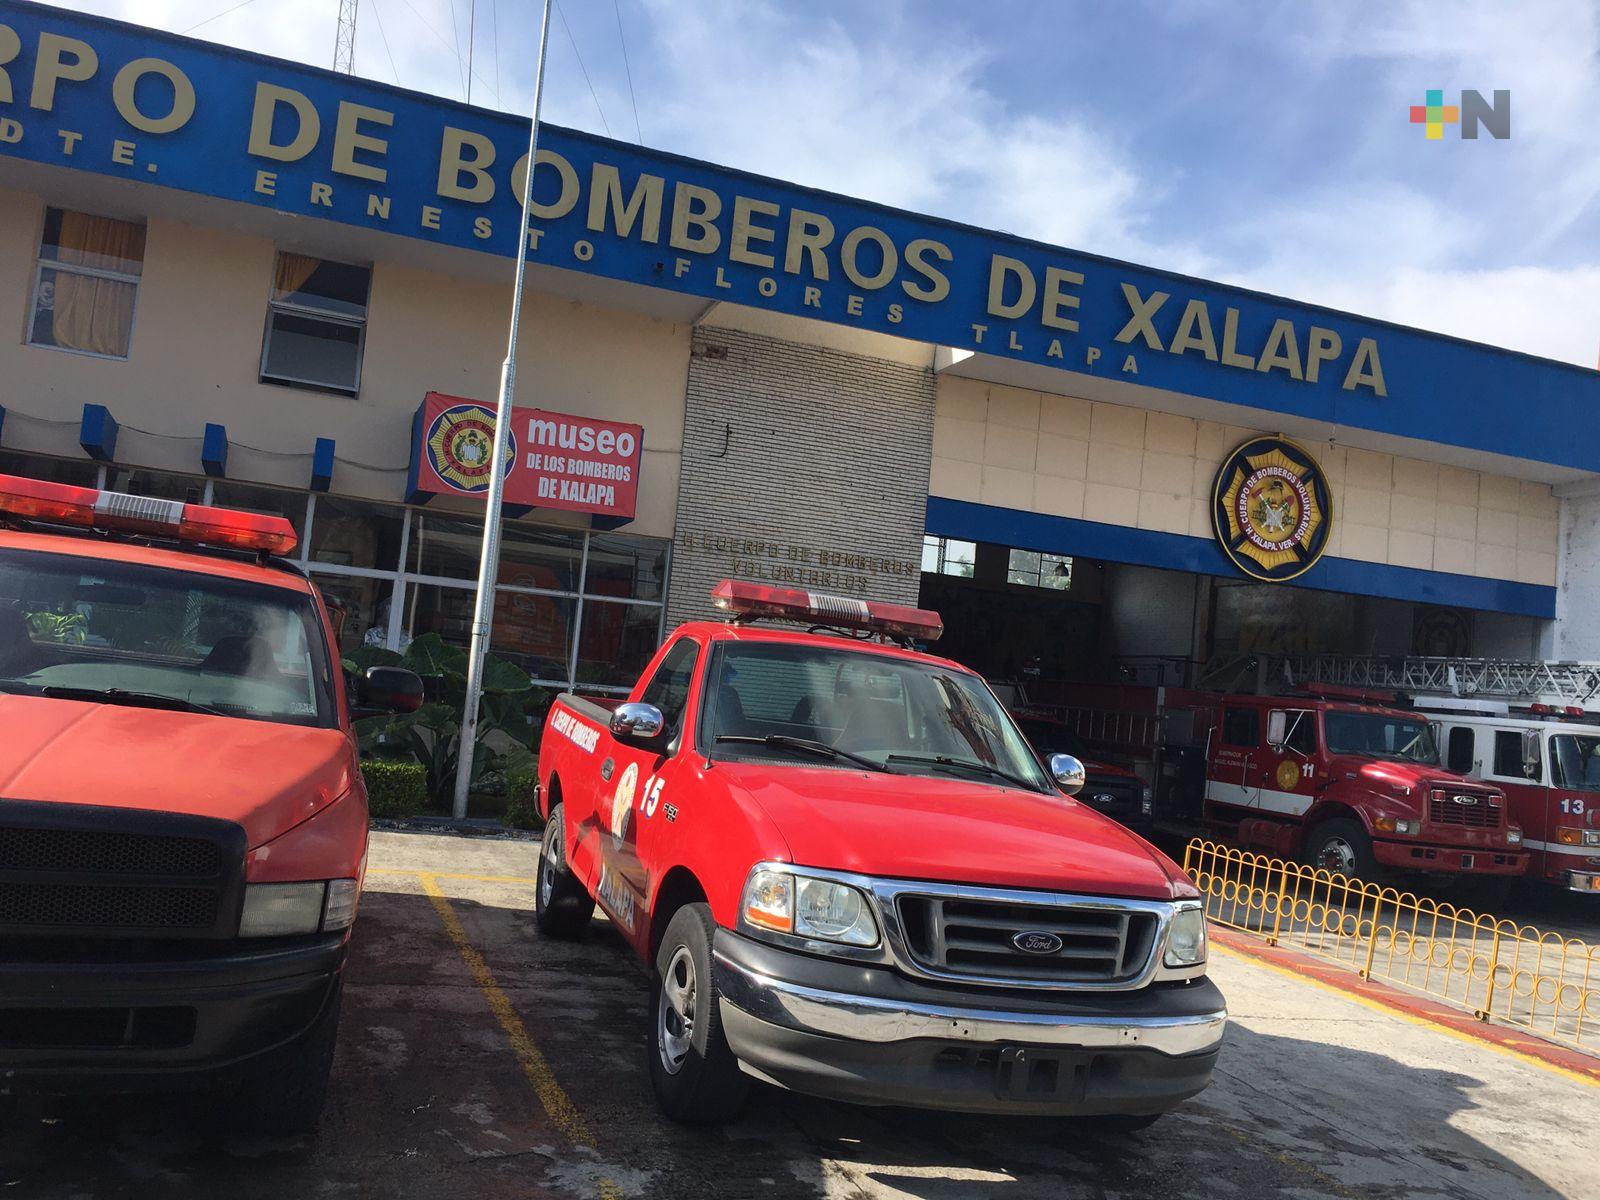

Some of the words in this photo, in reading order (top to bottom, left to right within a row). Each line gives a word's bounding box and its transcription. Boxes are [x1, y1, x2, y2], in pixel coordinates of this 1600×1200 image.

[248, 81, 394, 183] DE
[437, 126, 953, 302] BOMBEROS
[987, 254, 1085, 332] DE
[1114, 282, 1388, 397] XALAPA
[254, 170, 594, 261] ERNESTO
[674, 258, 904, 323] FLORES
[971, 323, 1139, 374] TLAPA
[528, 418, 635, 457] museo
[526, 452, 542, 470] DE
[543, 454, 565, 473] LOS
[567, 458, 631, 482] BOMBEROS
[538, 476, 557, 499] DE
[559, 479, 615, 506] XALAPA
[1240, 487, 1250, 523] CUERPO
[1247, 475, 1257, 487] DE
[1256, 466, 1297, 483] BOMBEROS
[1295, 481, 1310, 541] VOLUNTARIOS
[1302, 763, 1315, 778] 11
[640, 773, 666, 818] 15
[1561, 798, 1585, 815] 13
[1026, 935, 1052, 949] Ford
